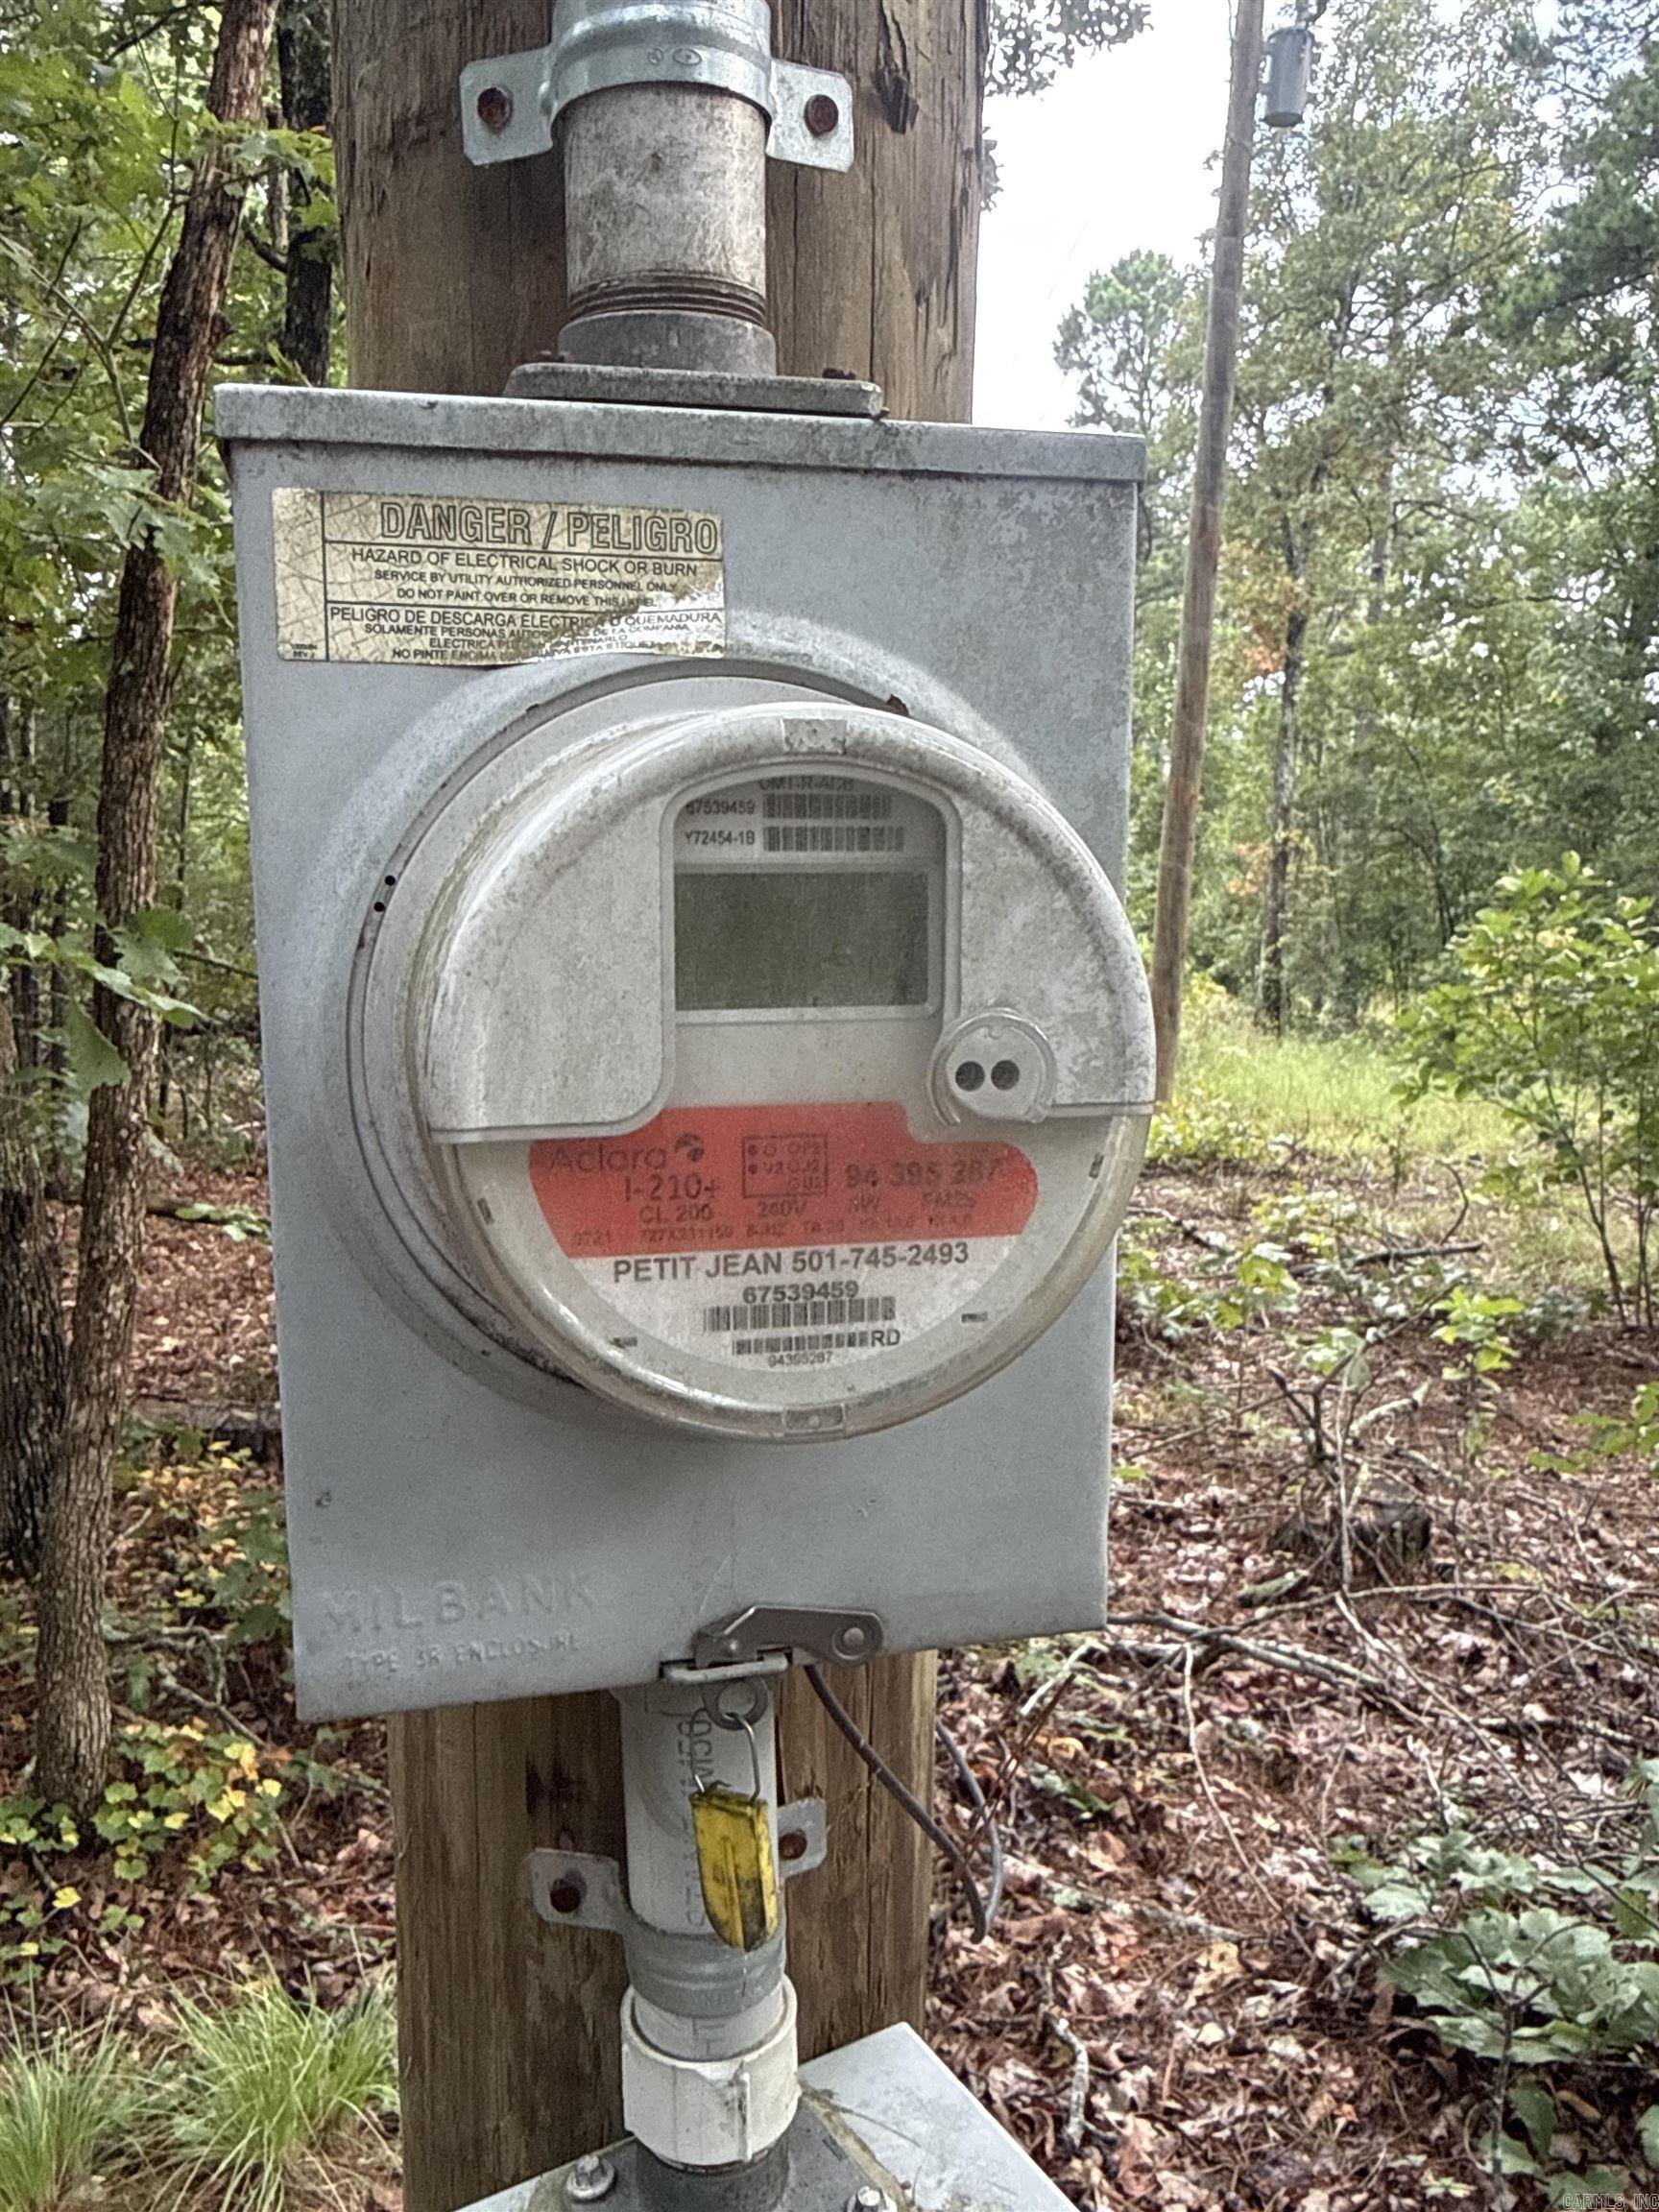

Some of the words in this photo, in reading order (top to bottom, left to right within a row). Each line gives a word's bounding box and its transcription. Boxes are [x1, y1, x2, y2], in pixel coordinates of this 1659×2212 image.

[380, 502, 532, 545] DANGER
[566, 511, 718, 555] PELIGRO
[351, 547, 422, 565] HAZARD
[427, 551, 451, 565] OF
[455, 552, 557, 571] ELECTRICAL
[563, 558, 619, 573] SHOCK
[624, 561, 648, 574] OR
[652, 562, 698, 576] BURN
[374, 569, 427, 582] SERVICE
[431, 571, 445, 582] BY
[451, 573, 493, 585] UTILITY
[495, 575, 571, 589] AUTHORIZED
[576, 579, 643, 591] PERSONNEL
[646, 581, 677, 592] ONLY
[397, 588, 415, 599] DO
[418, 589, 444, 600] NOT
[446, 589, 481, 602] PAINT
[484, 591, 517, 603] OVER
[520, 592, 537, 604] OR
[541, 593, 590, 606] REMOVE
[594, 595, 619, 606] THIS
[330, 607, 400, 623] PELIGRO
[404, 610, 427, 624] DE
[431, 611, 517, 627] DESCARGA
[365, 623, 437, 637] SOLAMENTE
[441, 626, 506, 638] PERSONAS
[393, 648, 411, 660] NO
[414, 649, 448, 661] PINTE
[685, 830, 757, 846] Y72454-1B
[638, 1204, 669, 1224] CL
[613, 1256, 695, 1284] PETIT
[705, 1251, 782, 1278] JEAN
[791, 1240, 969, 1275] 501-745-2493
[742, 1280, 858, 1305] 67539459
[870, 1329, 901, 1347] RD
